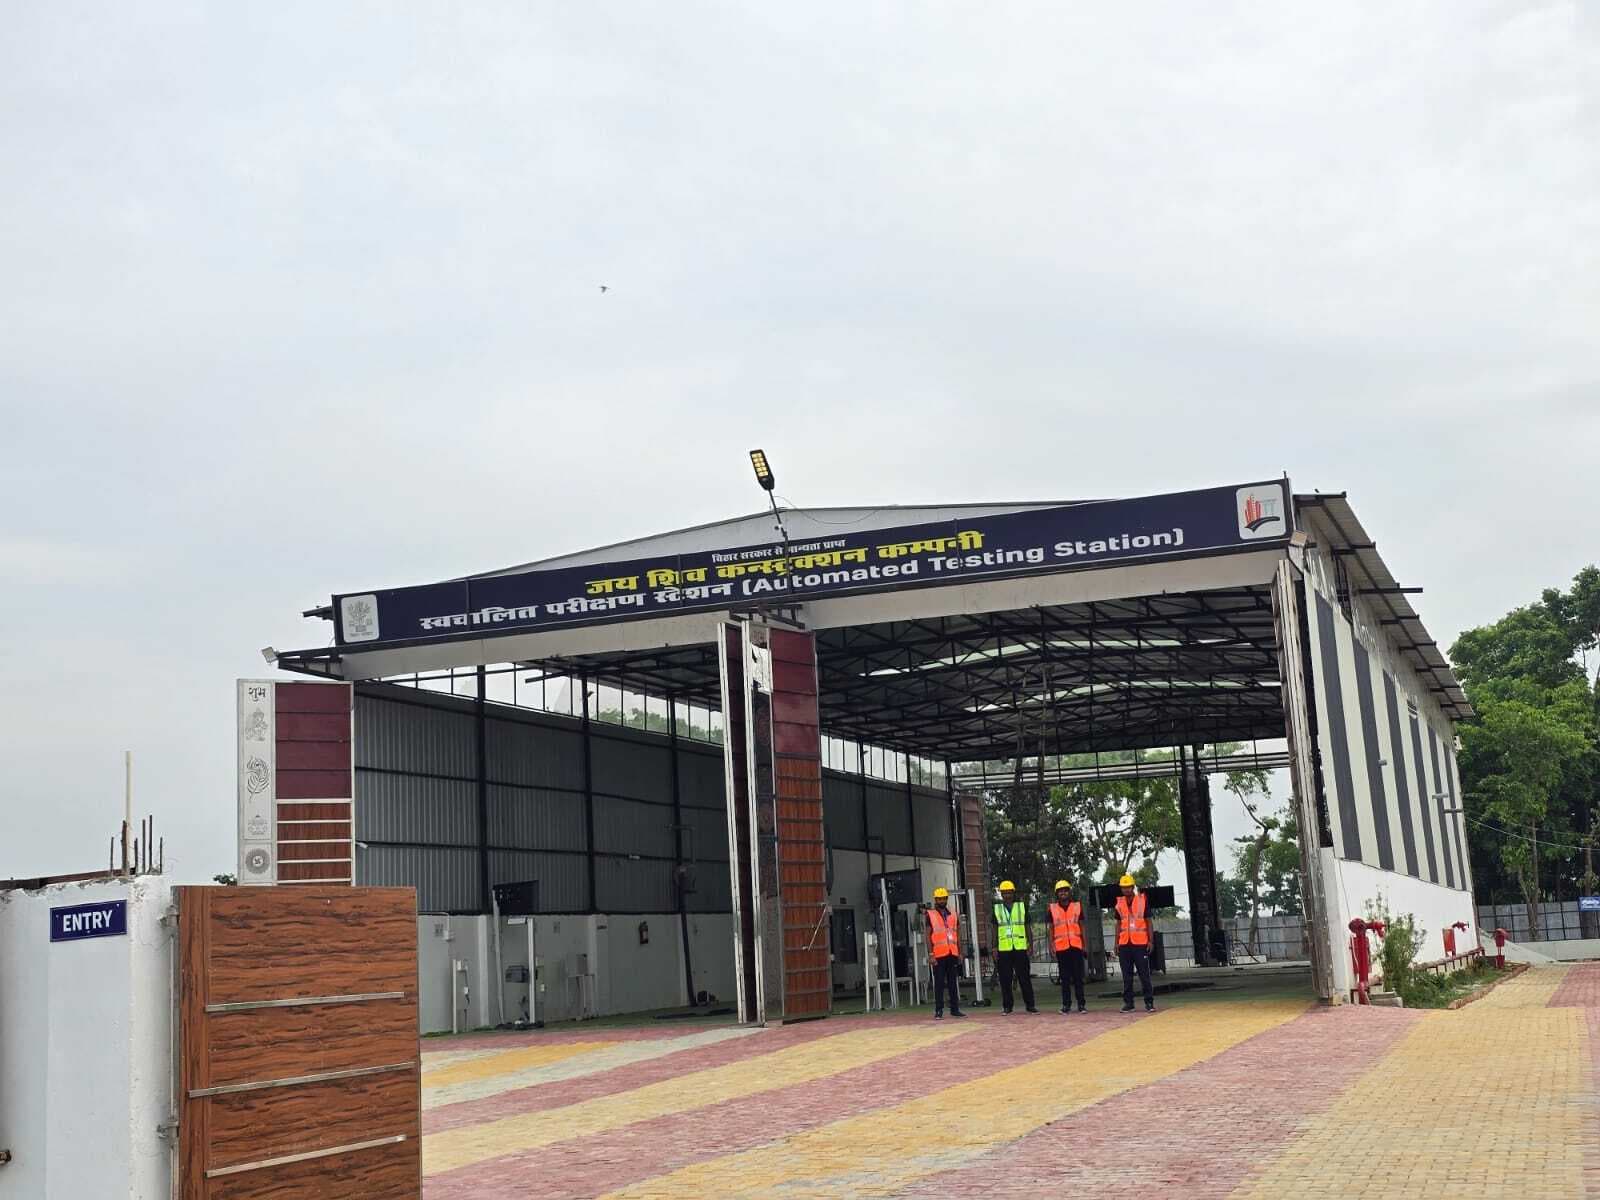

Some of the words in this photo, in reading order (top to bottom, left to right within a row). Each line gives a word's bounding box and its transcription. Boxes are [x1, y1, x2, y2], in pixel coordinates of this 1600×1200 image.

[545, 597, 647, 616] परीक्षण
[742, 559, 919, 596] (Automated
[928, 546, 1044, 572] Testing
[1054, 528, 1184, 558] Station)
[585, 575, 639, 594] जय
[646, 568, 708, 588] शिव
[63, 910, 113, 932] ENTRY
